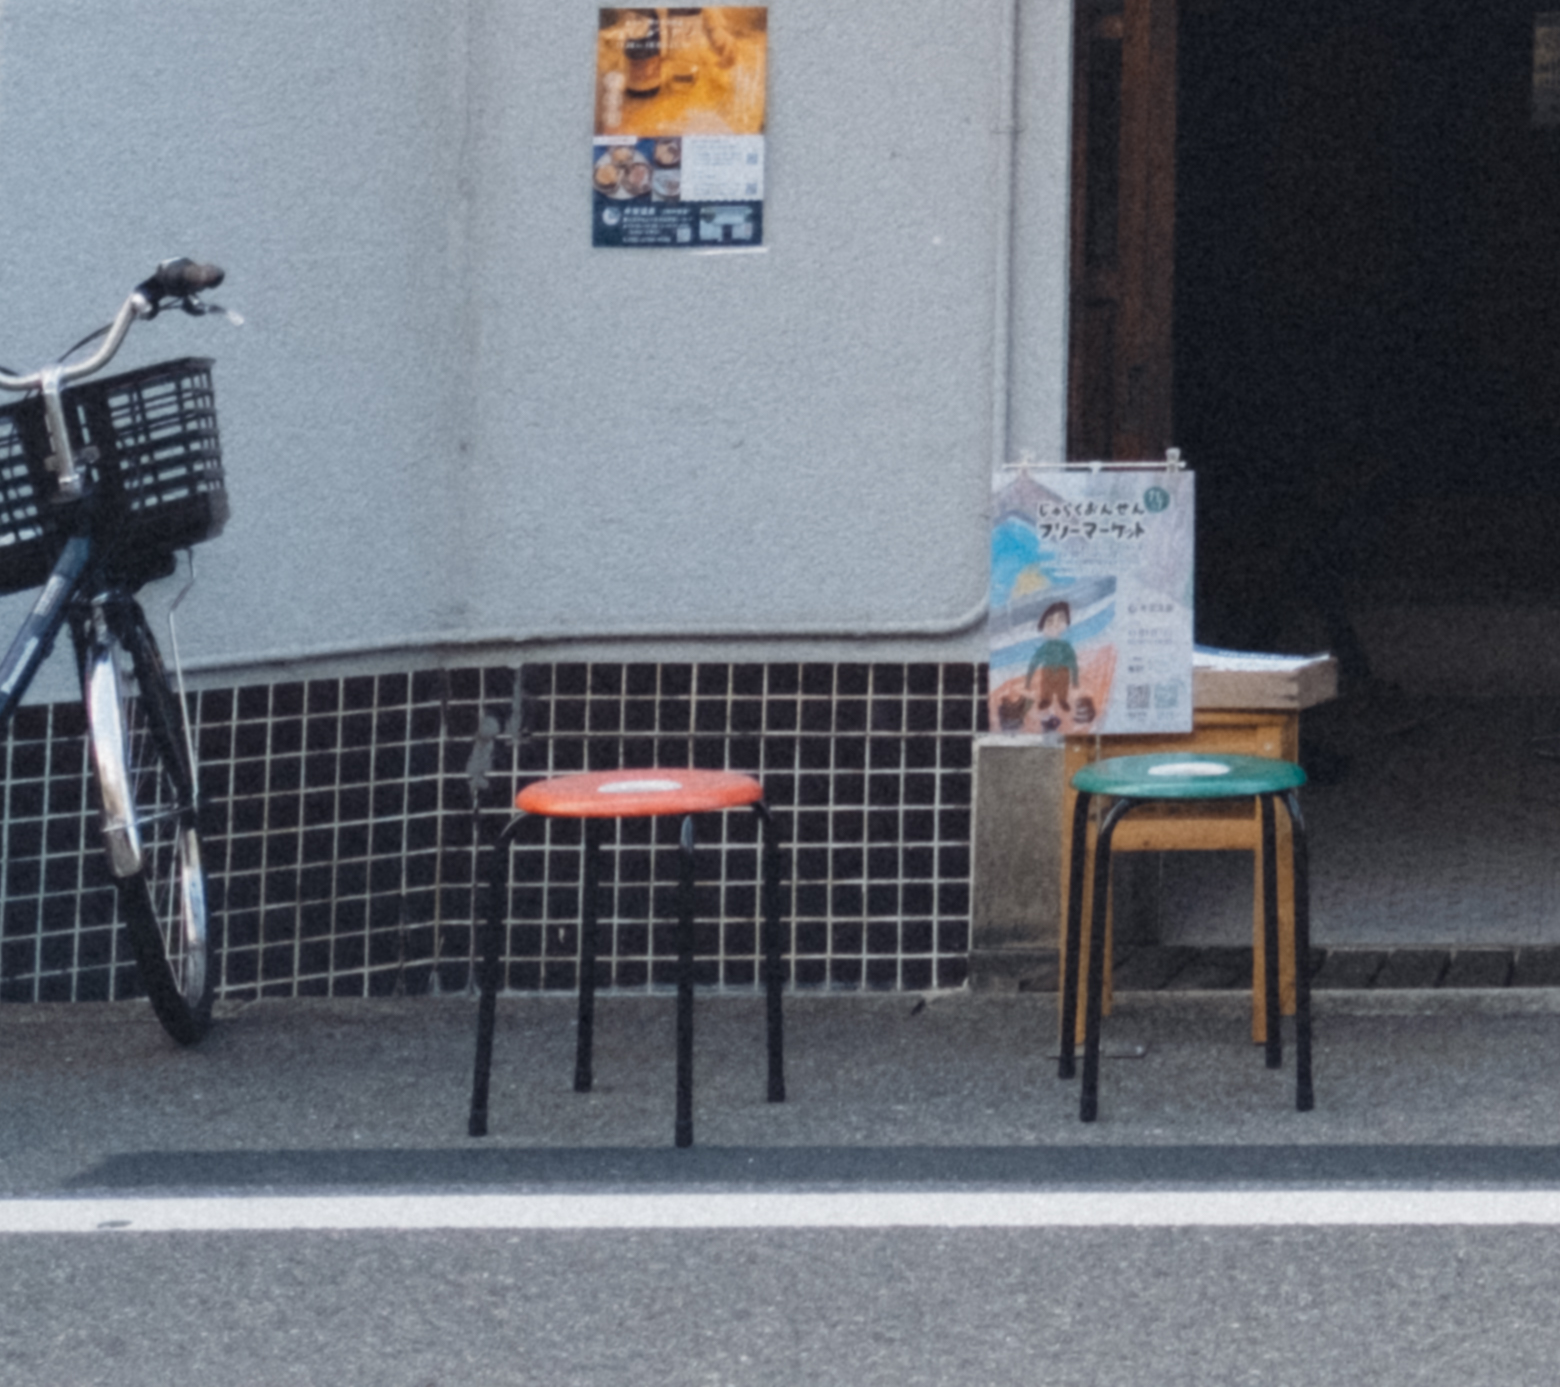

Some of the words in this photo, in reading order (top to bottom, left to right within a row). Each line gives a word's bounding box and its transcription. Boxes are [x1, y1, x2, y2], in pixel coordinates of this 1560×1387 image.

[1038, 502, 1145, 517] じゅらくおんせん
[1038, 521, 1145, 539] フリーマーケット
